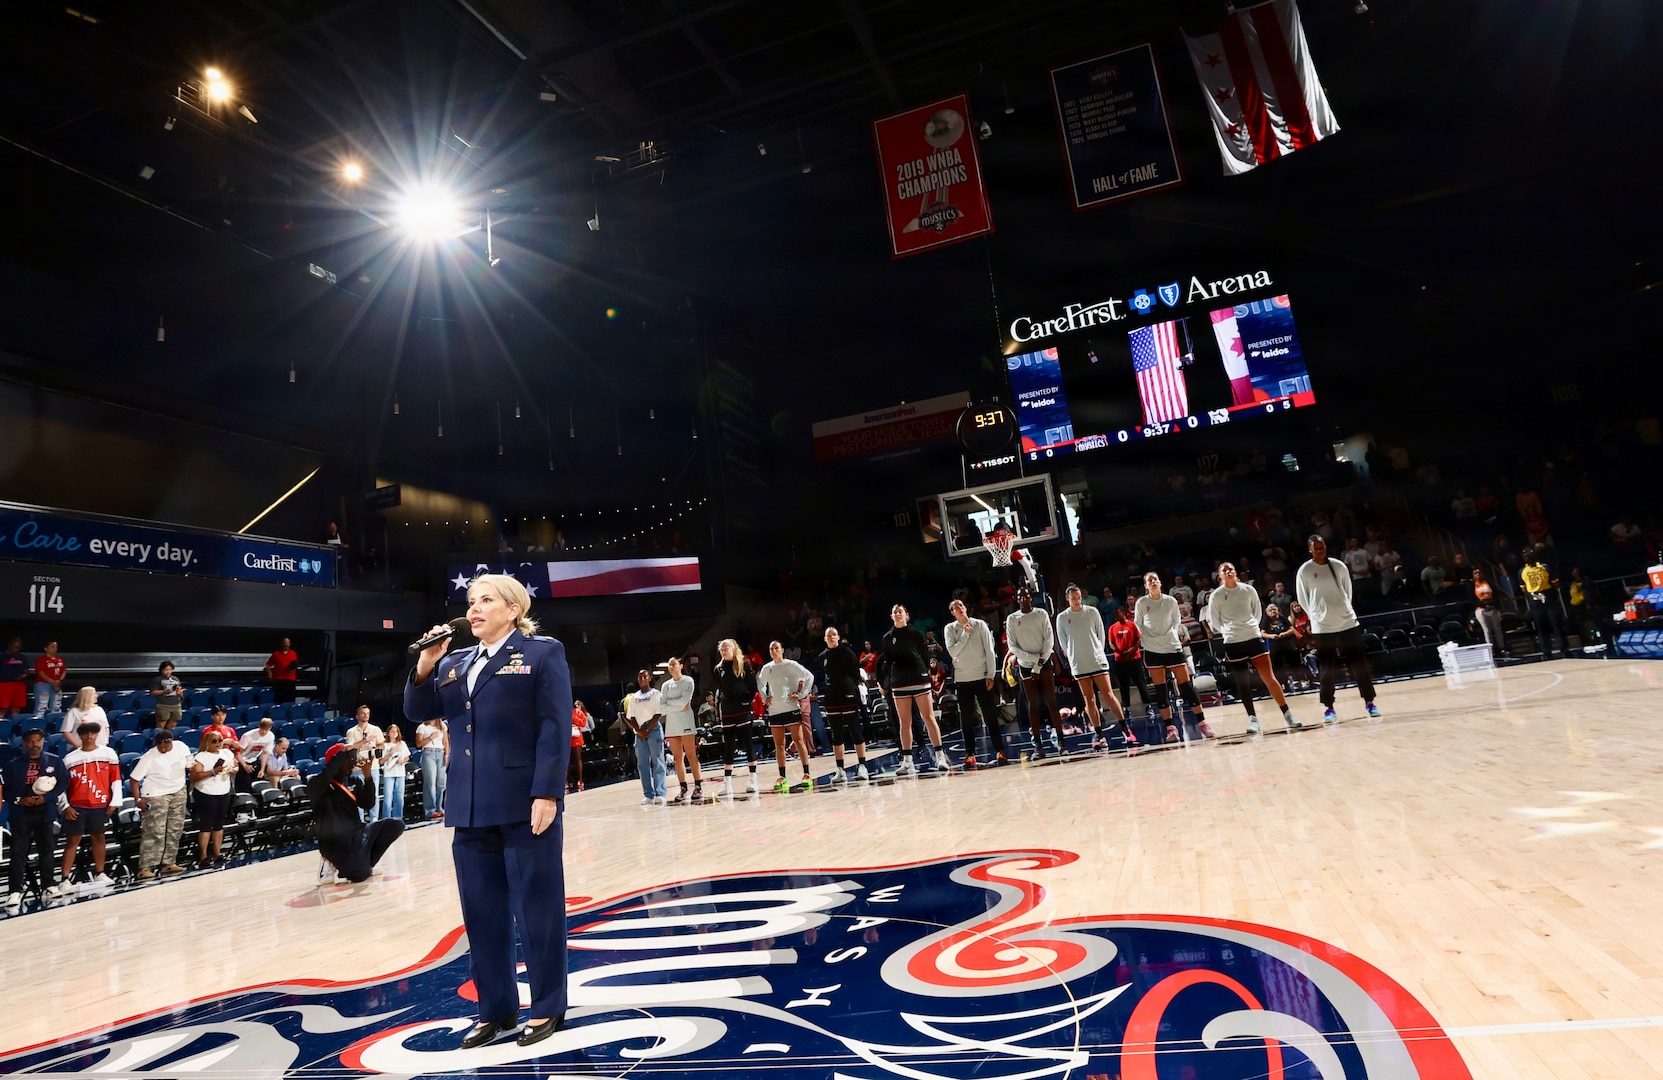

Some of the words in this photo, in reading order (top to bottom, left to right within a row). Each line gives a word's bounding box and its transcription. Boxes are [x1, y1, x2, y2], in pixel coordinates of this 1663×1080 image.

[896, 158, 925, 182] 2019
[926, 147, 962, 172] WNBA
[1092, 174, 1119, 194] HALL
[1119, 172, 1129, 185] of
[1129, 162, 1159, 184] FAME
[897, 164, 968, 200] CHAMPIONS
[1186, 270, 1273, 303] Arena
[1248, 336, 1284, 350] PRESENTED
[1262, 347, 1290, 359] leidos
[1018, 388, 1050, 400] PRESENTED
[1050, 386, 1059, 394] BY
[1030, 398, 1056, 409] leidos
[1266, 404, 1274, 412] 0
[1283, 400, 1290, 409] 5
[975, 410, 1004, 428] 9:37
[1030, 452, 1038, 461] 5
[1046, 449, 1054, 457] 0
[1117, 430, 1128, 442] 0
[1143, 424, 1170, 437] 9:37
[1187, 415, 1199, 428] 0
[14, 521, 82, 551] Care
[89, 537, 151, 563] every
[156, 541, 198, 567] day.
[33, 575, 61, 583] SECTION
[29, 584, 64, 614] 114
[70, 769, 108, 804] MYSTICS
